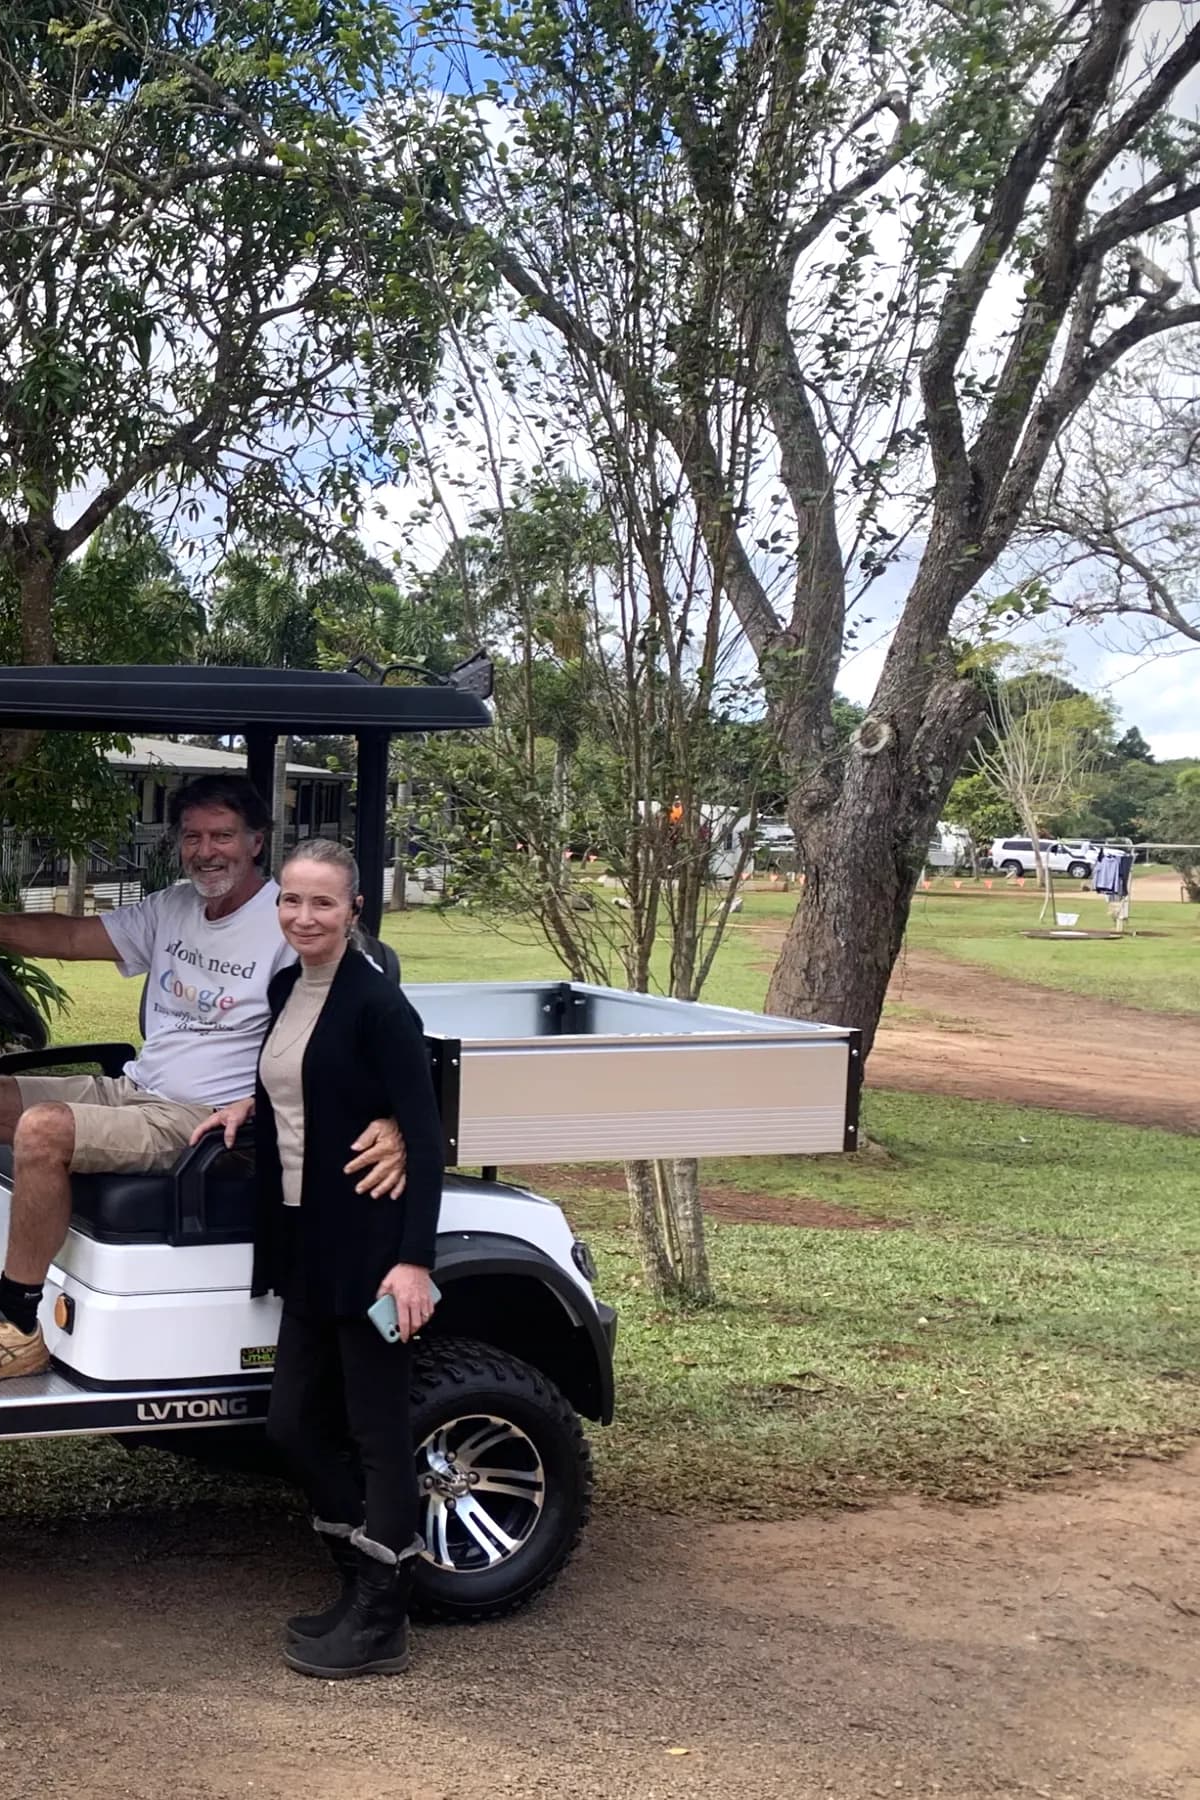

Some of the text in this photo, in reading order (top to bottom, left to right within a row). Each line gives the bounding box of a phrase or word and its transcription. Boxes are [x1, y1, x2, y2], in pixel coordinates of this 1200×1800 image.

[207, 957, 257, 980] need
[242, 1352, 276, 1362] LITHIU
[137, 1397, 249, 1421] LVTONG
